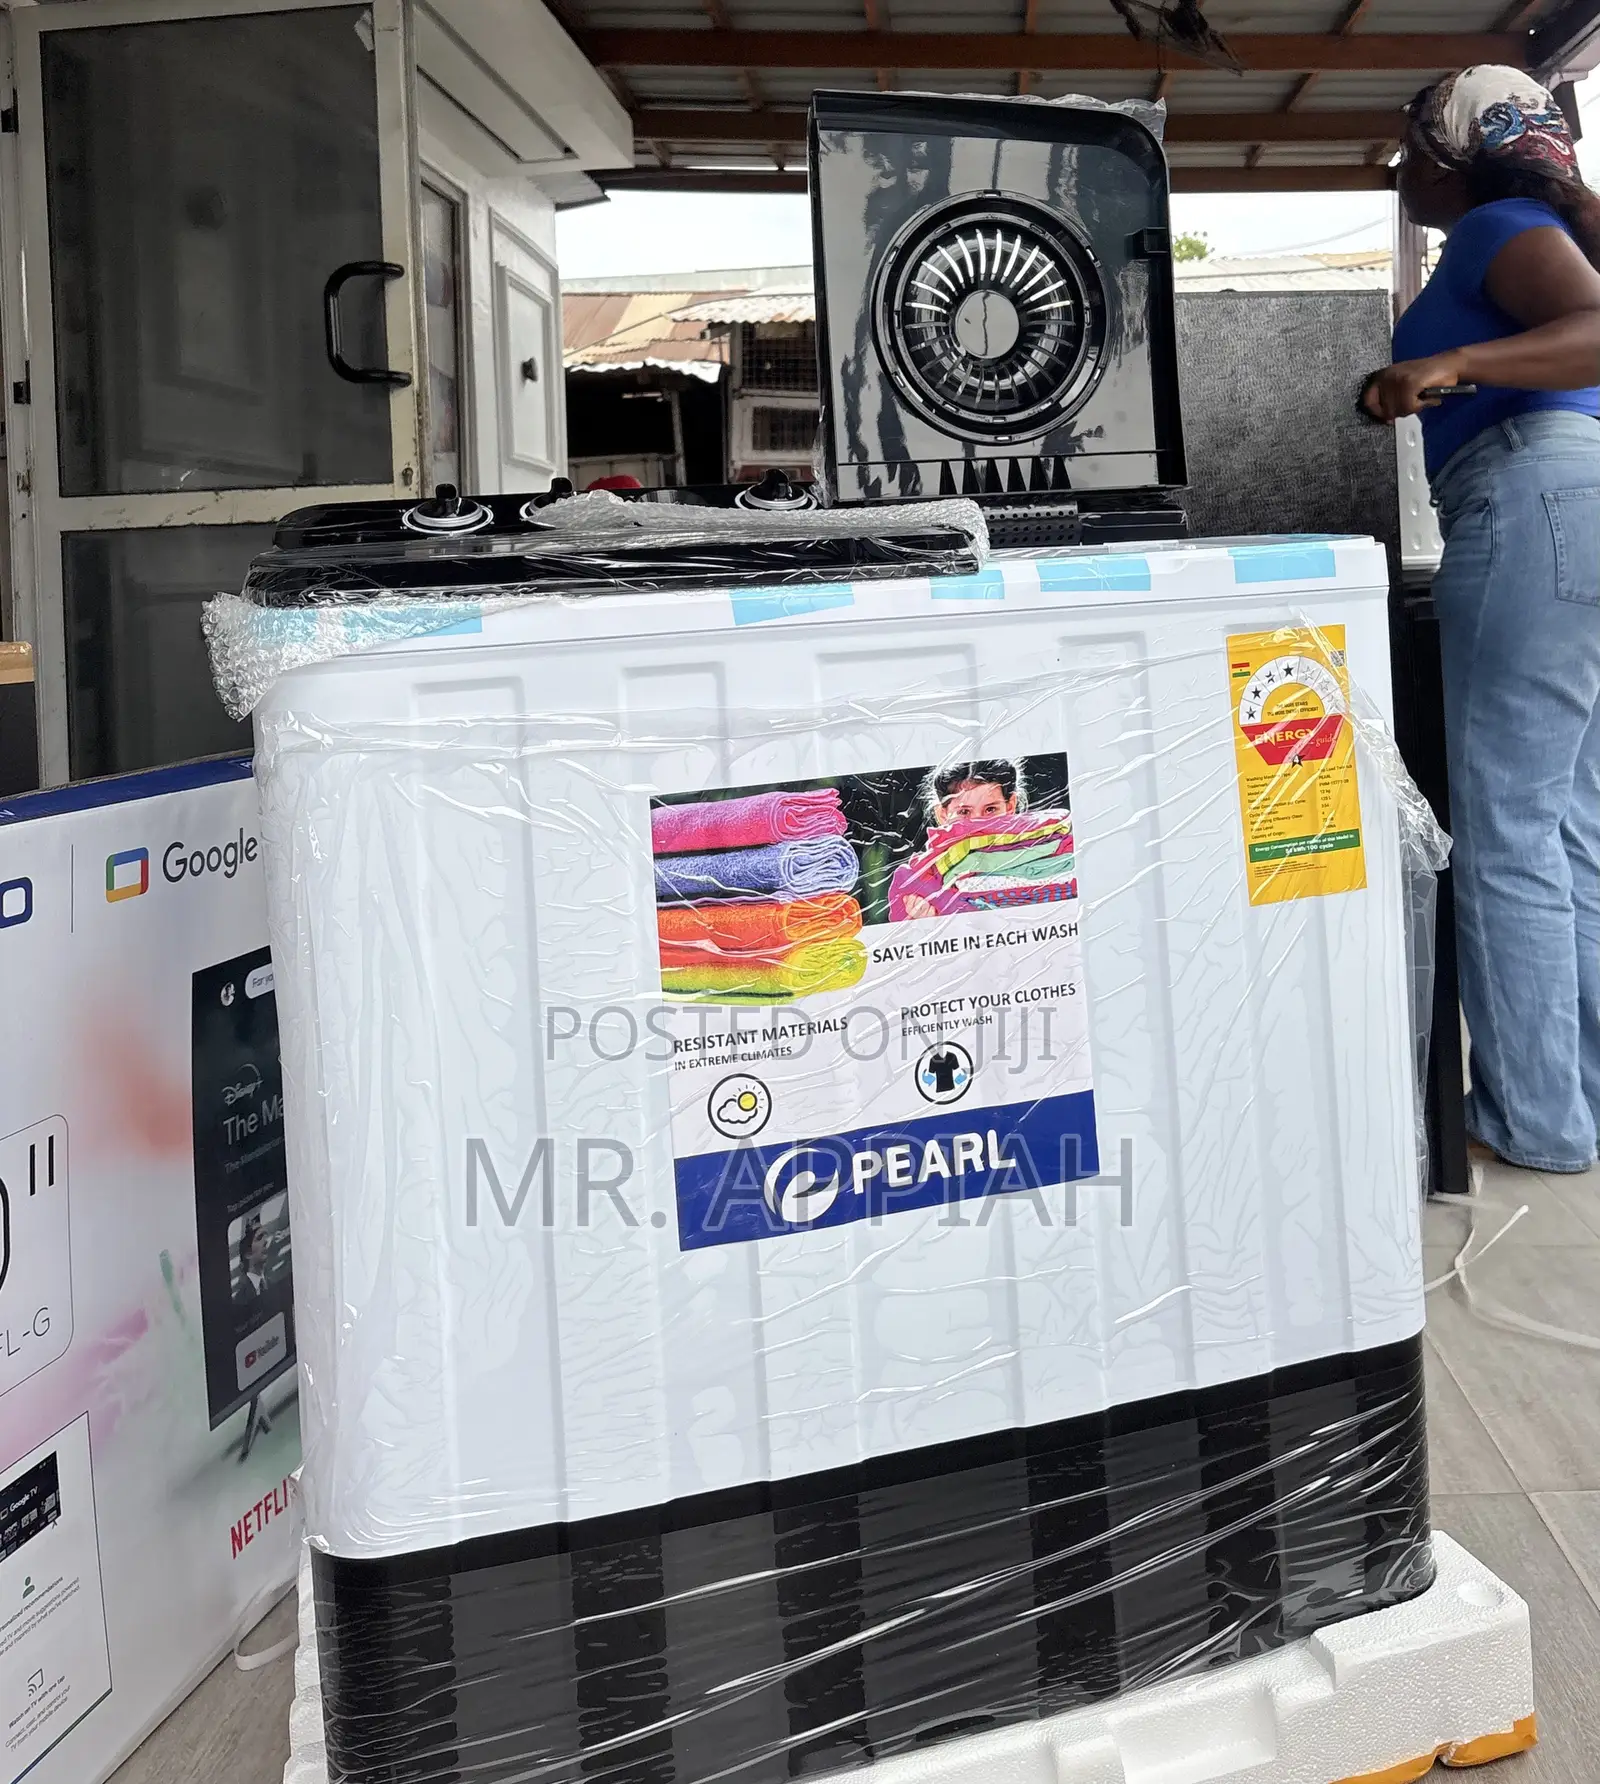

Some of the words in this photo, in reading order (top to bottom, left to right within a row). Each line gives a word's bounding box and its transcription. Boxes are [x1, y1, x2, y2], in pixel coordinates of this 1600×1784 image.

[1255, 728, 1313, 746] ENERGY
[162, 827, 258, 883] Google
[872, 944, 914, 964] SAVE
[918, 937, 959, 958] TIME
[964, 934, 981, 951] IN
[986, 929, 1028, 949] EACH
[1031, 921, 1080, 942] WASH
[901, 997, 966, 1020] PROTECT
[968, 992, 1012, 1009] YOUR
[1014, 982, 1077, 1005] CLOTHES
[673, 1029, 758, 1054] RESISTANT
[762, 1016, 849, 1042] MATERIALS
[901, 1019, 960, 1037] EFFICIENTLY
[962, 1015, 994, 1028] WASH
[674, 1060, 686, 1071] IN
[689, 1053, 738, 1069] EXTREME
[741, 1046, 793, 1062] CLIMATES
[223, 1112, 259, 1146] The
[262, 1093, 285, 1128] Ma
[851, 1129, 1017, 1195] PEARL
[230, 1478, 289, 1560] NETFLI
